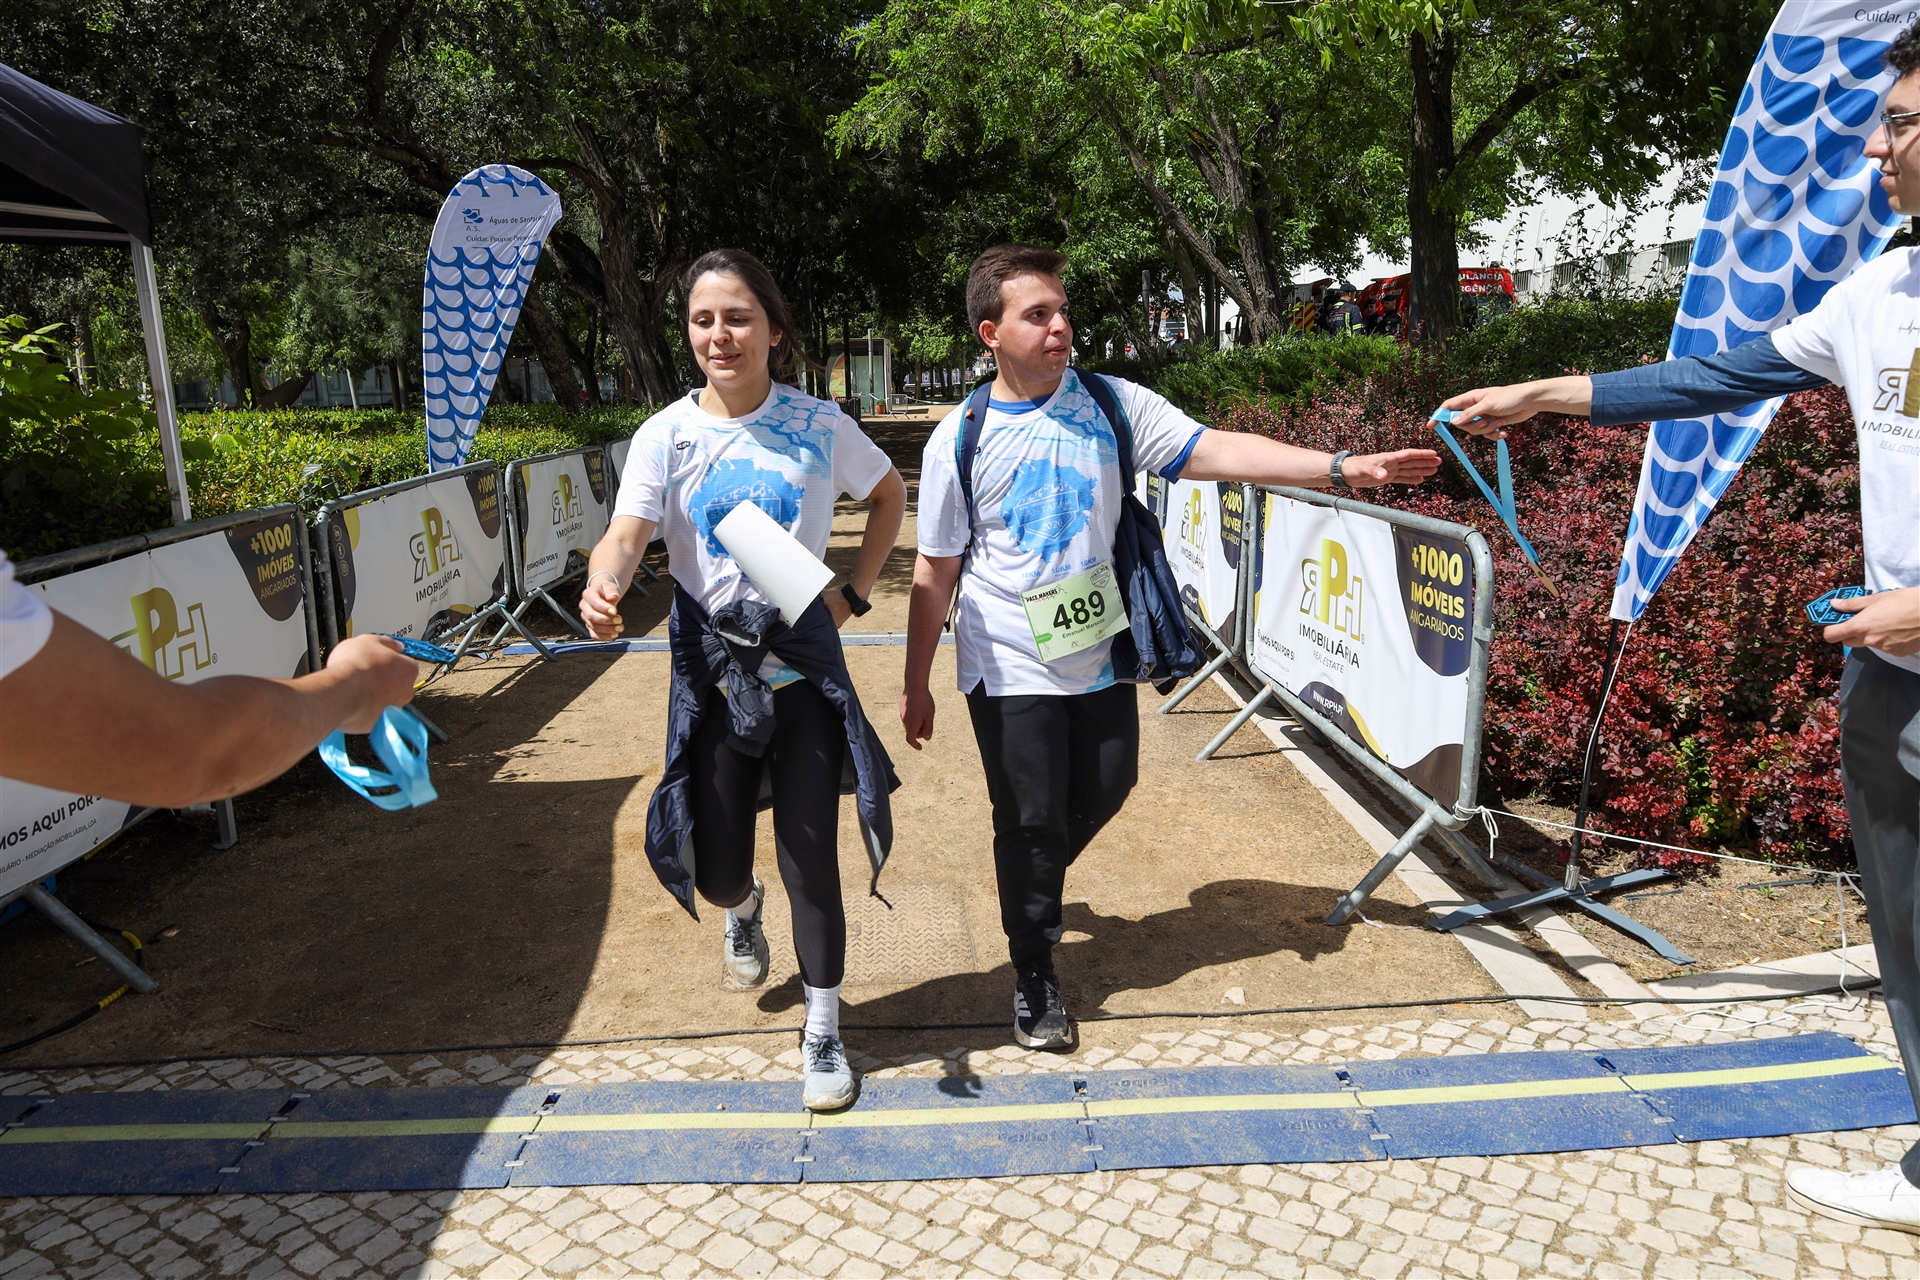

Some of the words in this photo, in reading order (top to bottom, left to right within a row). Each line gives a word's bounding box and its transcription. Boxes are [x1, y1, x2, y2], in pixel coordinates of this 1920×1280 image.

[1854, 9, 1902, 23] Cuidar.
[489, 216, 509, 225] Águas
[250, 523, 292, 555] +1000
[257, 553, 295, 583] IMÓVEIS
[1411, 544, 1464, 586] +1000
[260, 574, 297, 600] ANGARIADOS
[1410, 581, 1465, 619] IMÓVEIS
[1053, 590, 1105, 631] 489
[1409, 608, 1465, 641] ANGARIADOS
[1062, 626, 1086, 639] Emanuel
[1299, 623, 1360, 669] IMOBILIÁRIA
[1322, 656, 1345, 674] ESTATE
[31, 807, 66, 836] AQUI
[68, 793, 94, 817] POR
[25, 841, 55, 862] MEDIAÇÃO
[88, 818, 97, 829] LDA
